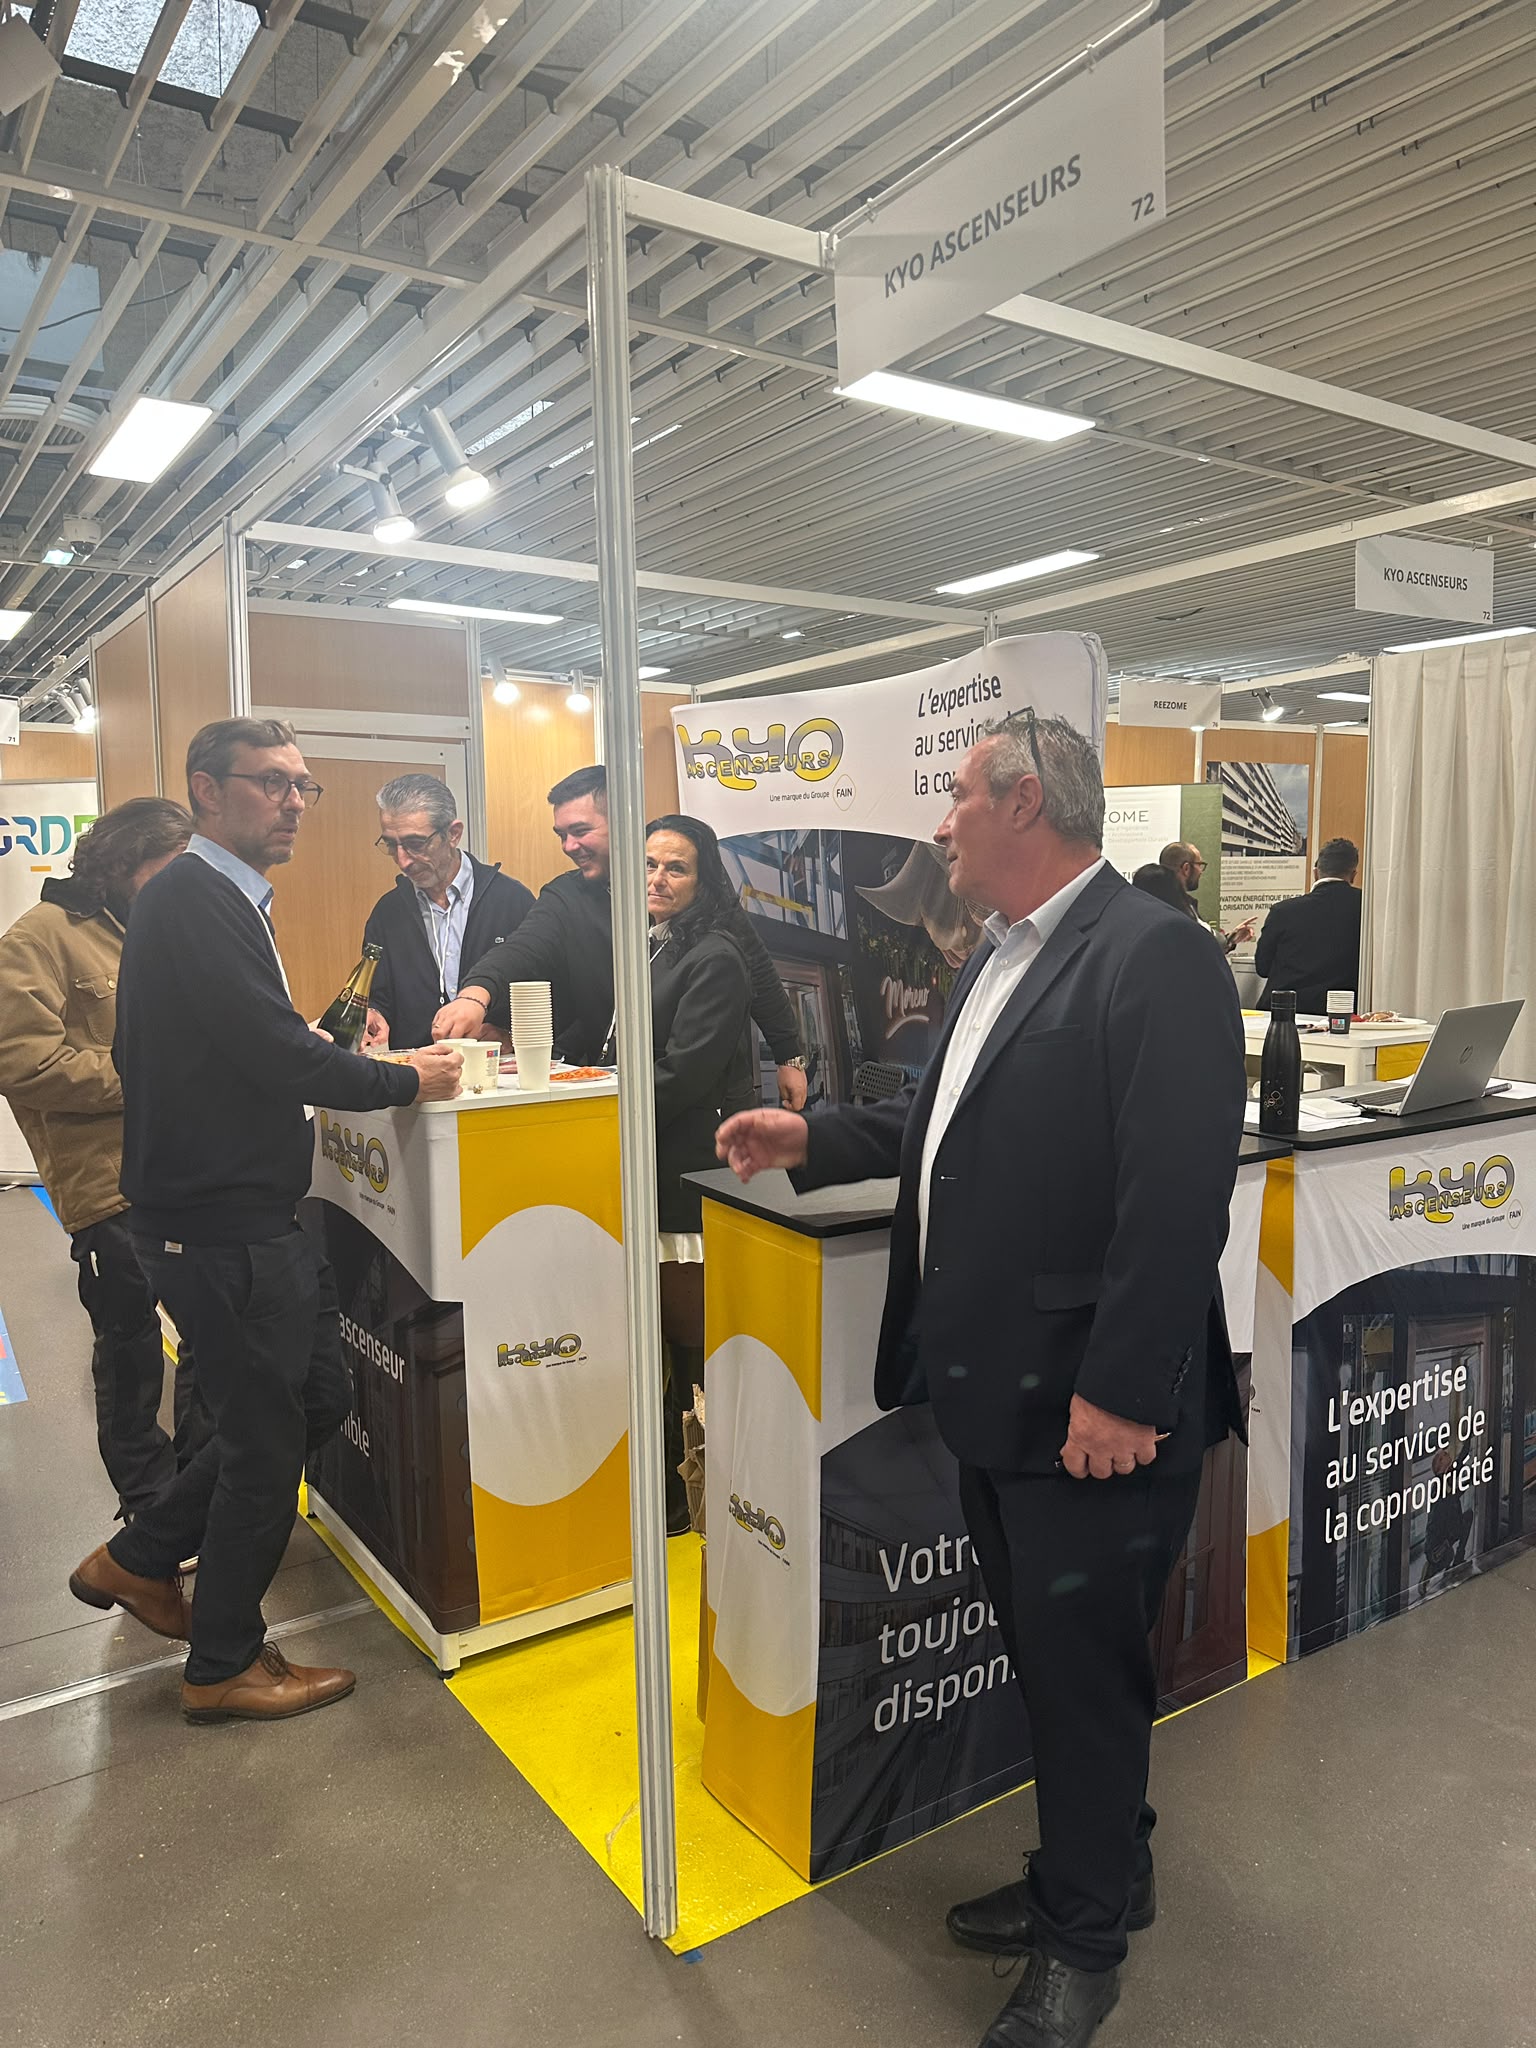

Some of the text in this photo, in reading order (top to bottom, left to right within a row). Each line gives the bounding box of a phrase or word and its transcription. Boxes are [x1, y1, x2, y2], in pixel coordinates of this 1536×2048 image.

[1131, 192, 1156, 222] 72
[884, 154, 1082, 298] KYO ASCENSEURS
[1384, 567, 1468, 591] KYO ASCENSEURS
[1482, 610, 1491, 620] 72
[918, 673, 1002, 718] L'expertise
[1153, 700, 1188, 711] REEZOME
[915, 734, 934, 757] au
[687, 750, 831, 779] ASCENSEURS
[836, 787, 853, 798] FAIN
[915, 769, 928, 796] la
[1390, 1180, 1507, 1221] ASCENSEURS
[1328, 1364, 1467, 1433] L'expertise
[1326, 1405, 1485, 1489] au service de
[1325, 1446, 1494, 1544] la copropriété
[874, 1653, 1017, 1732] dispon
